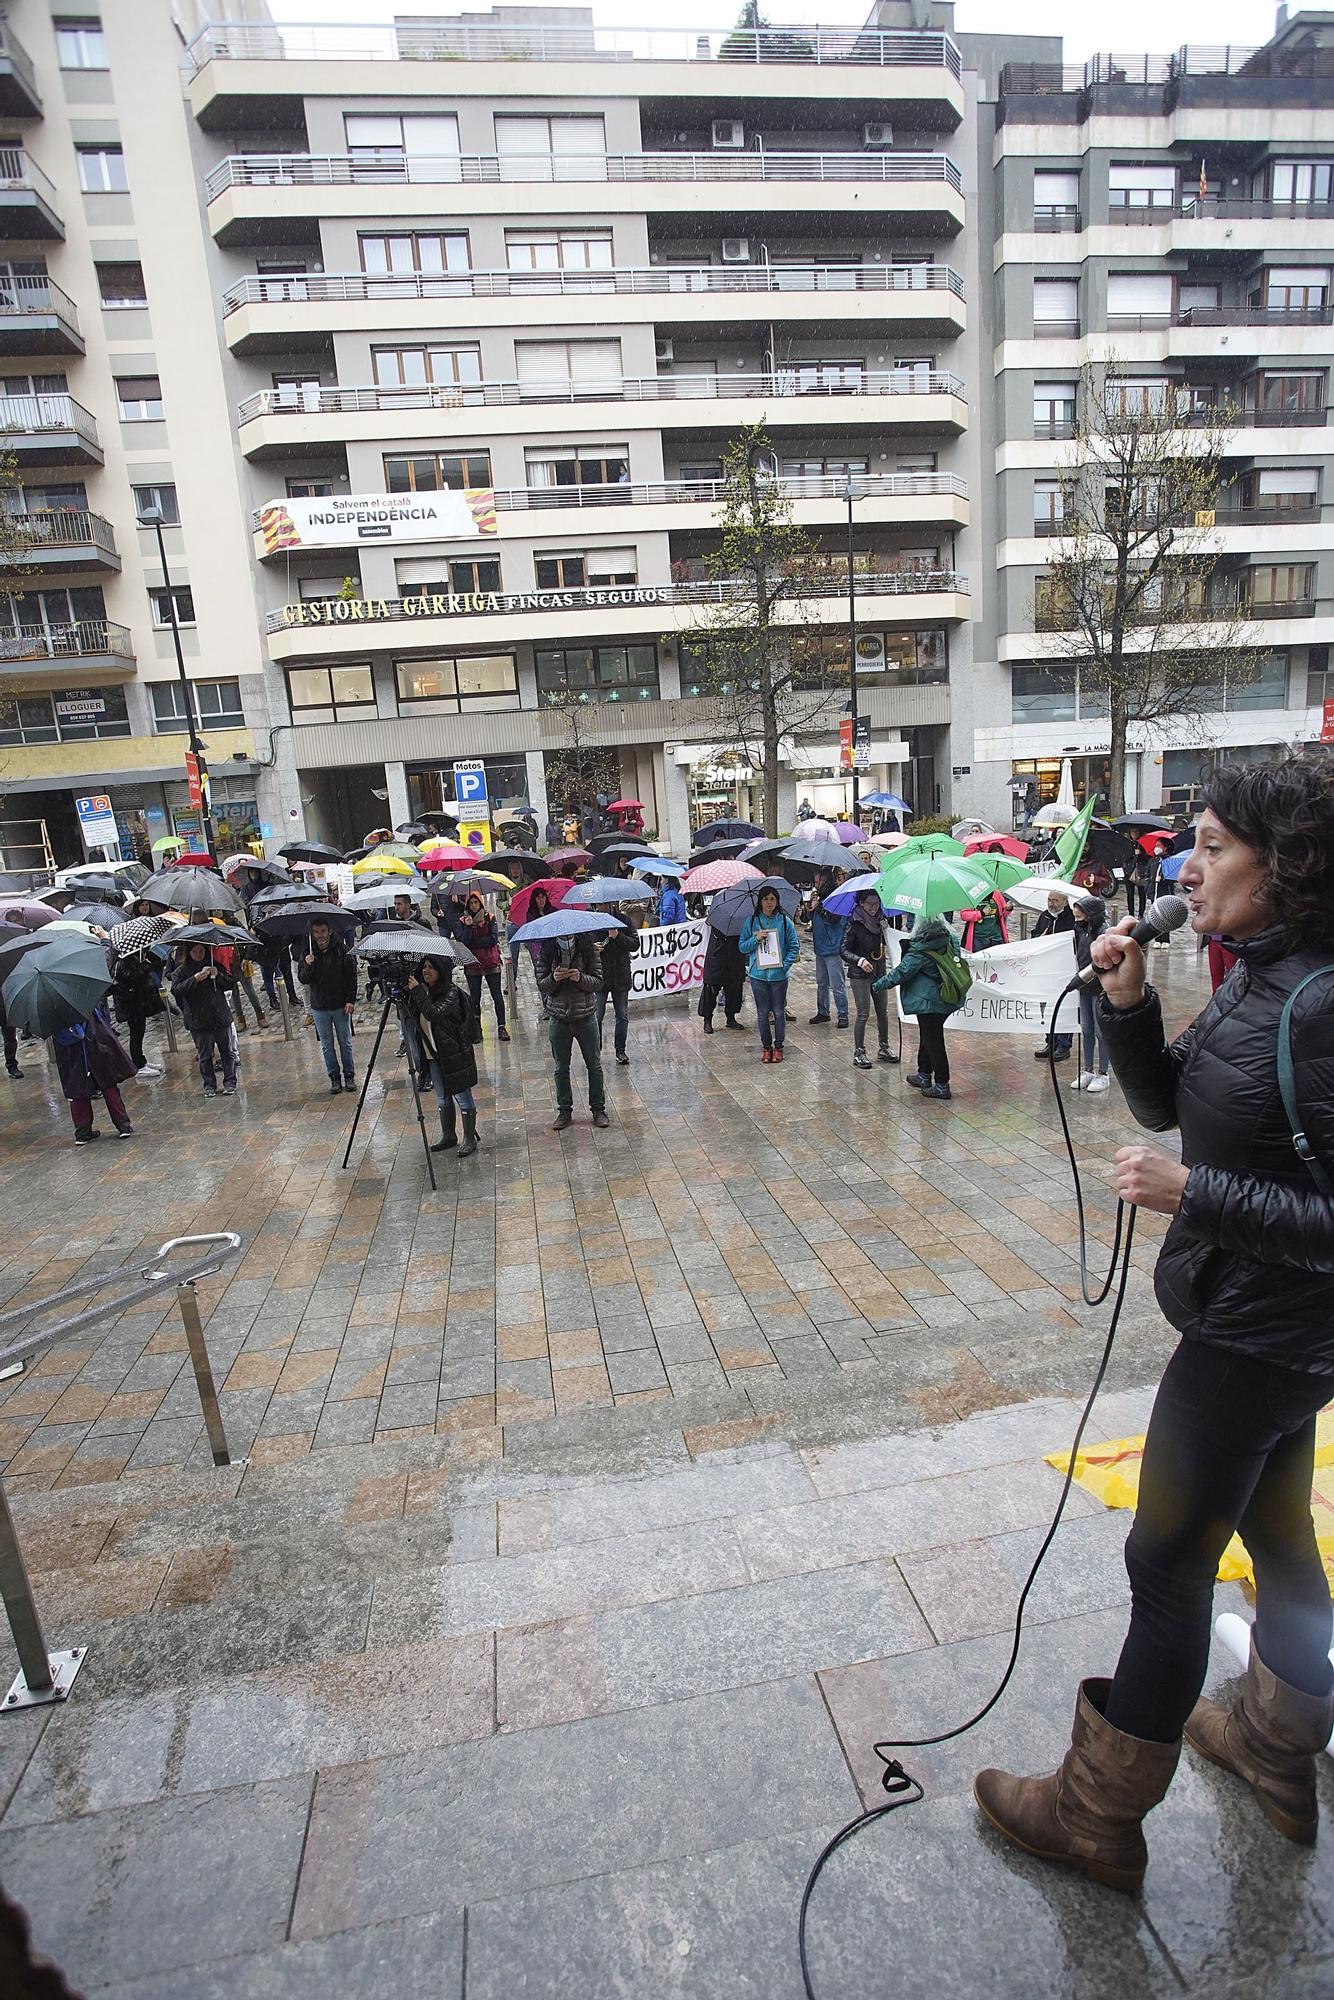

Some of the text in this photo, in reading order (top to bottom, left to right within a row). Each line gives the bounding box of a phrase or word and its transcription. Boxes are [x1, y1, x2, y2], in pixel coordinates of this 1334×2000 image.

[333, 496, 412, 510] Salvem el català
[308, 507, 438, 526] INDEPENDÈNCIA
[283, 589, 668, 625] GESTORIA GARRIGA FINCAS SEGUROS
[60, 702, 102, 713] LLOGUER
[456, 762, 482, 771] Motos
[705, 762, 753, 782] Stein
[461, 774, 480, 800] P
[80, 800, 90, 812] P
[211, 804, 258, 820] Stein
[631, 928, 703, 960] UR$OS
